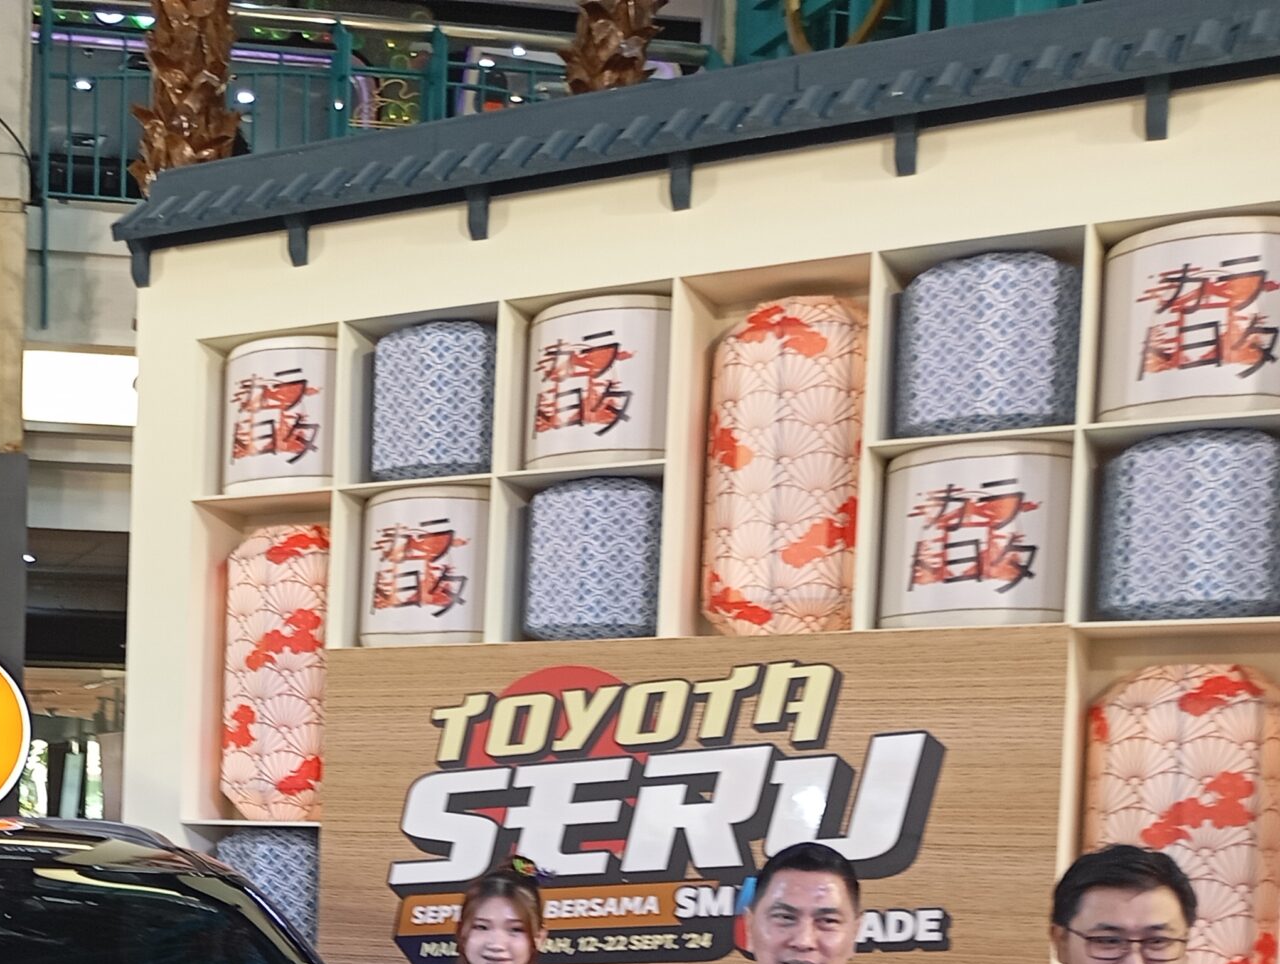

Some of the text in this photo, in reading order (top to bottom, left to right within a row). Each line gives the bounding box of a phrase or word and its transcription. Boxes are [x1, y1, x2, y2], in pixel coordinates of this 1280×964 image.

[431, 660, 838, 764] TOYOTA
[388, 731, 932, 887] SERU
[543, 895, 660, 919] BERSAMA
[577, 935, 628, 952] 12-22
